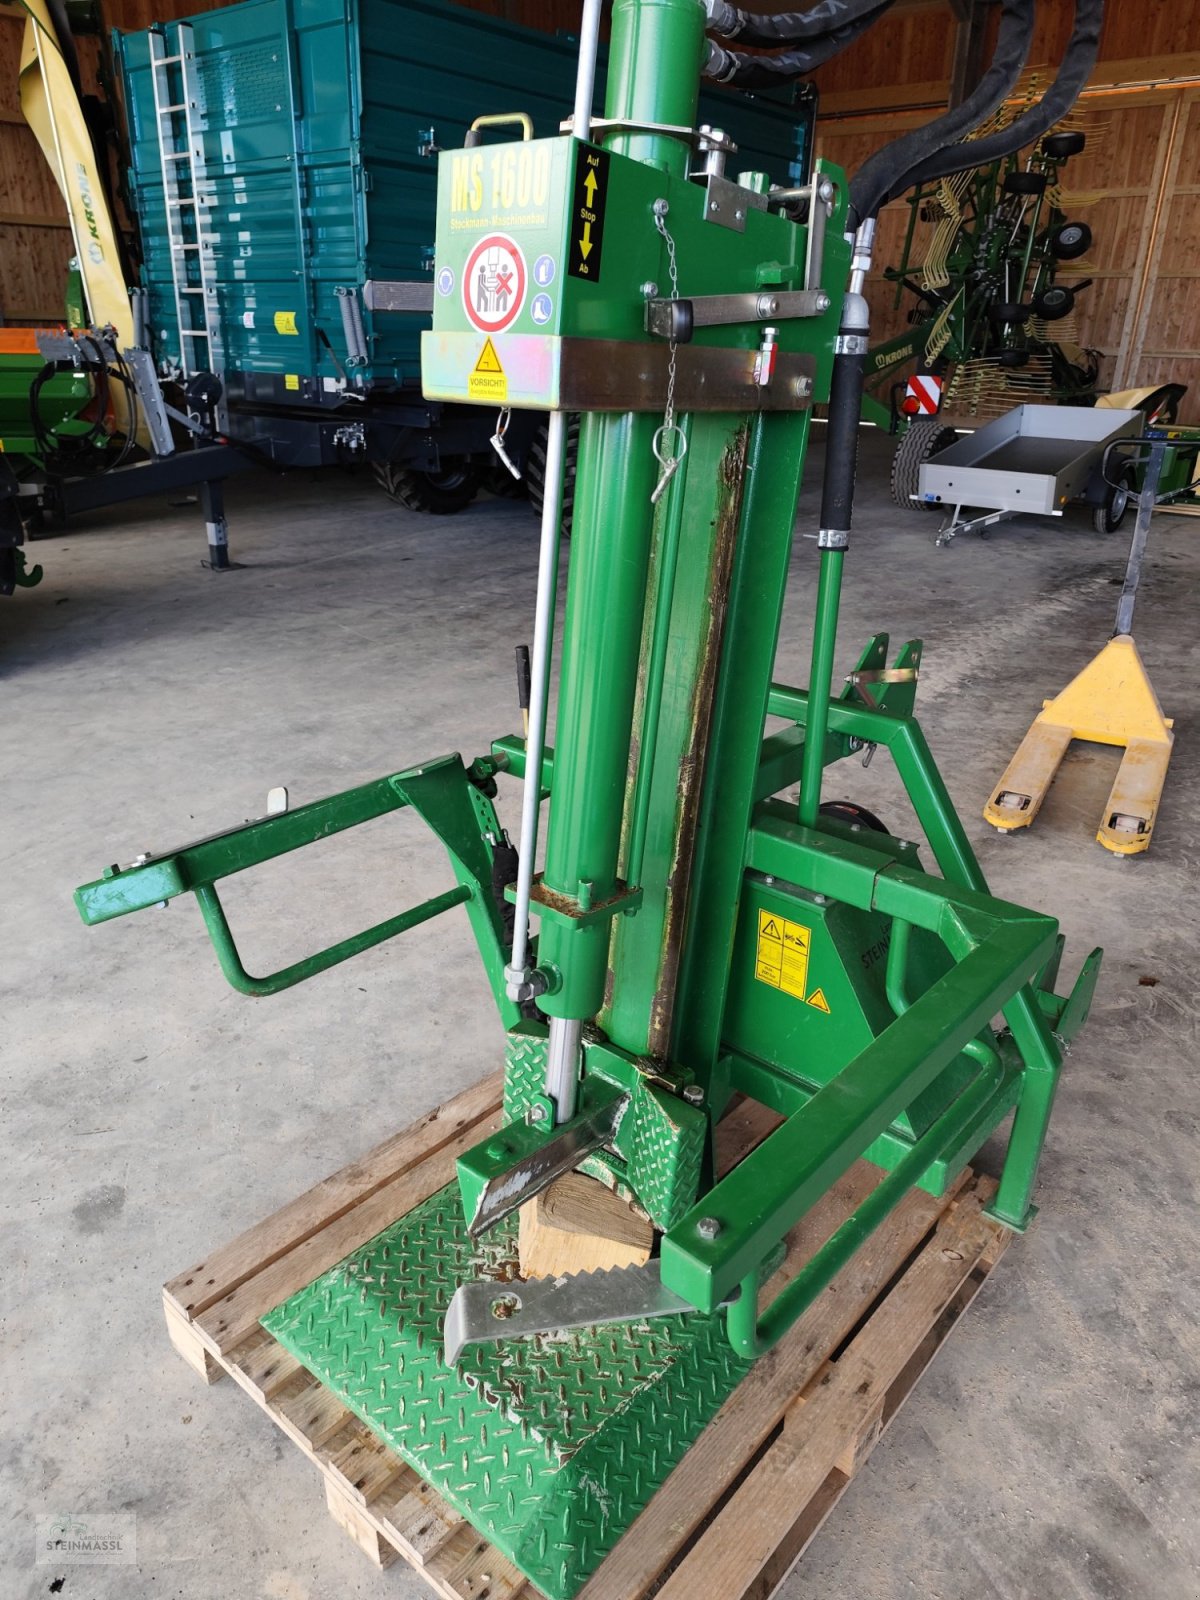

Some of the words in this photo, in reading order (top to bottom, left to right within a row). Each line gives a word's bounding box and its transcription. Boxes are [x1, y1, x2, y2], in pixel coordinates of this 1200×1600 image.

[586, 154, 600, 167] Auf
[451, 153, 483, 212] MS
[490, 146, 549, 209] 1600
[580, 208, 596, 223] Stop
[578, 263, 589, 274] Ab
[885, 344, 912, 365] KRONE
